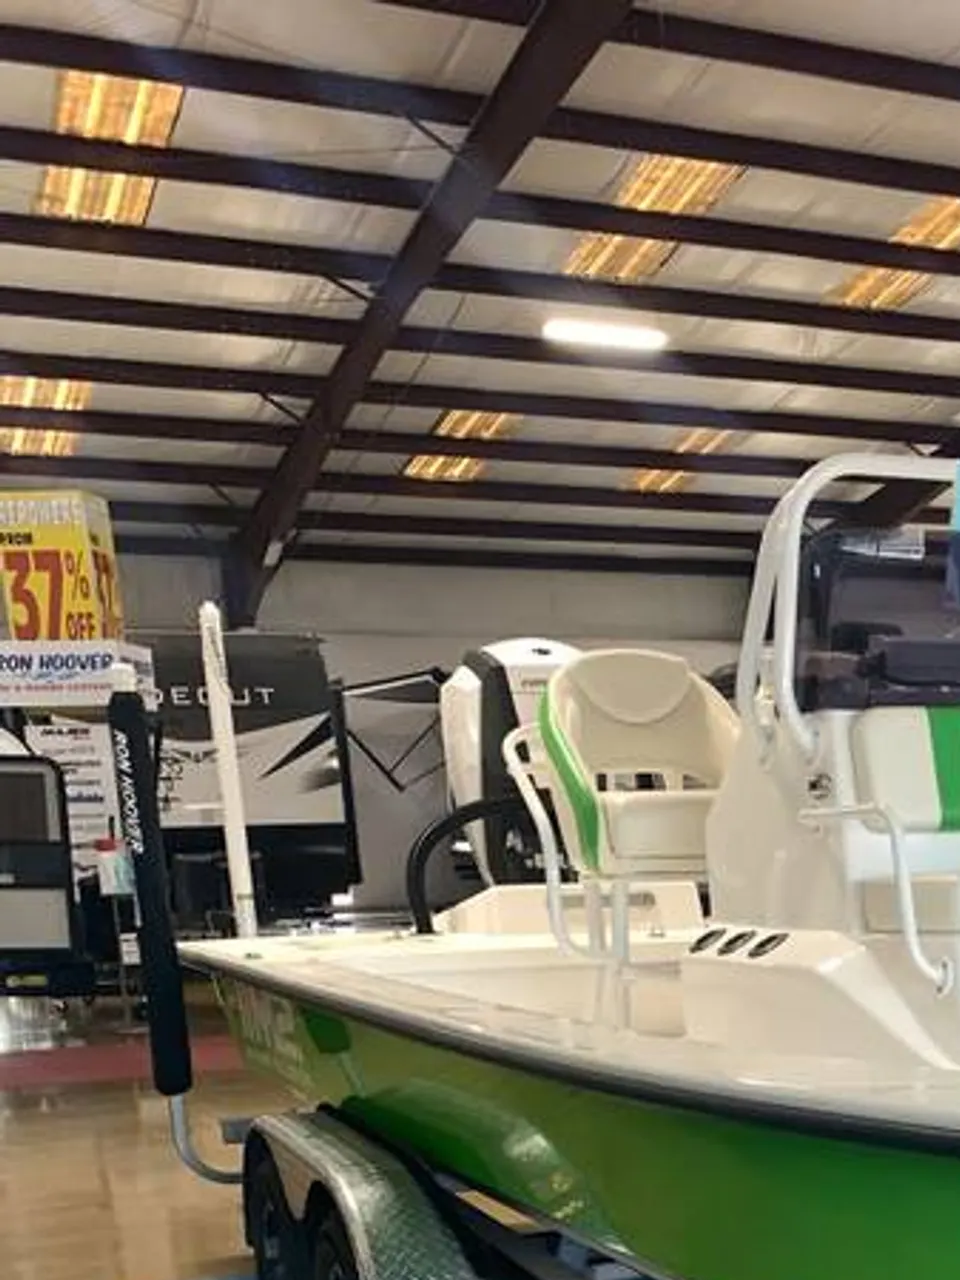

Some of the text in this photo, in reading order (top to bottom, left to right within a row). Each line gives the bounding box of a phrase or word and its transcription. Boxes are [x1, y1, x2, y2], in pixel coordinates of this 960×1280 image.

[65, 611, 96, 641] OFF
[39, 652, 113, 671] HOOVER
[114, 729, 145, 854] RON HOOVER
